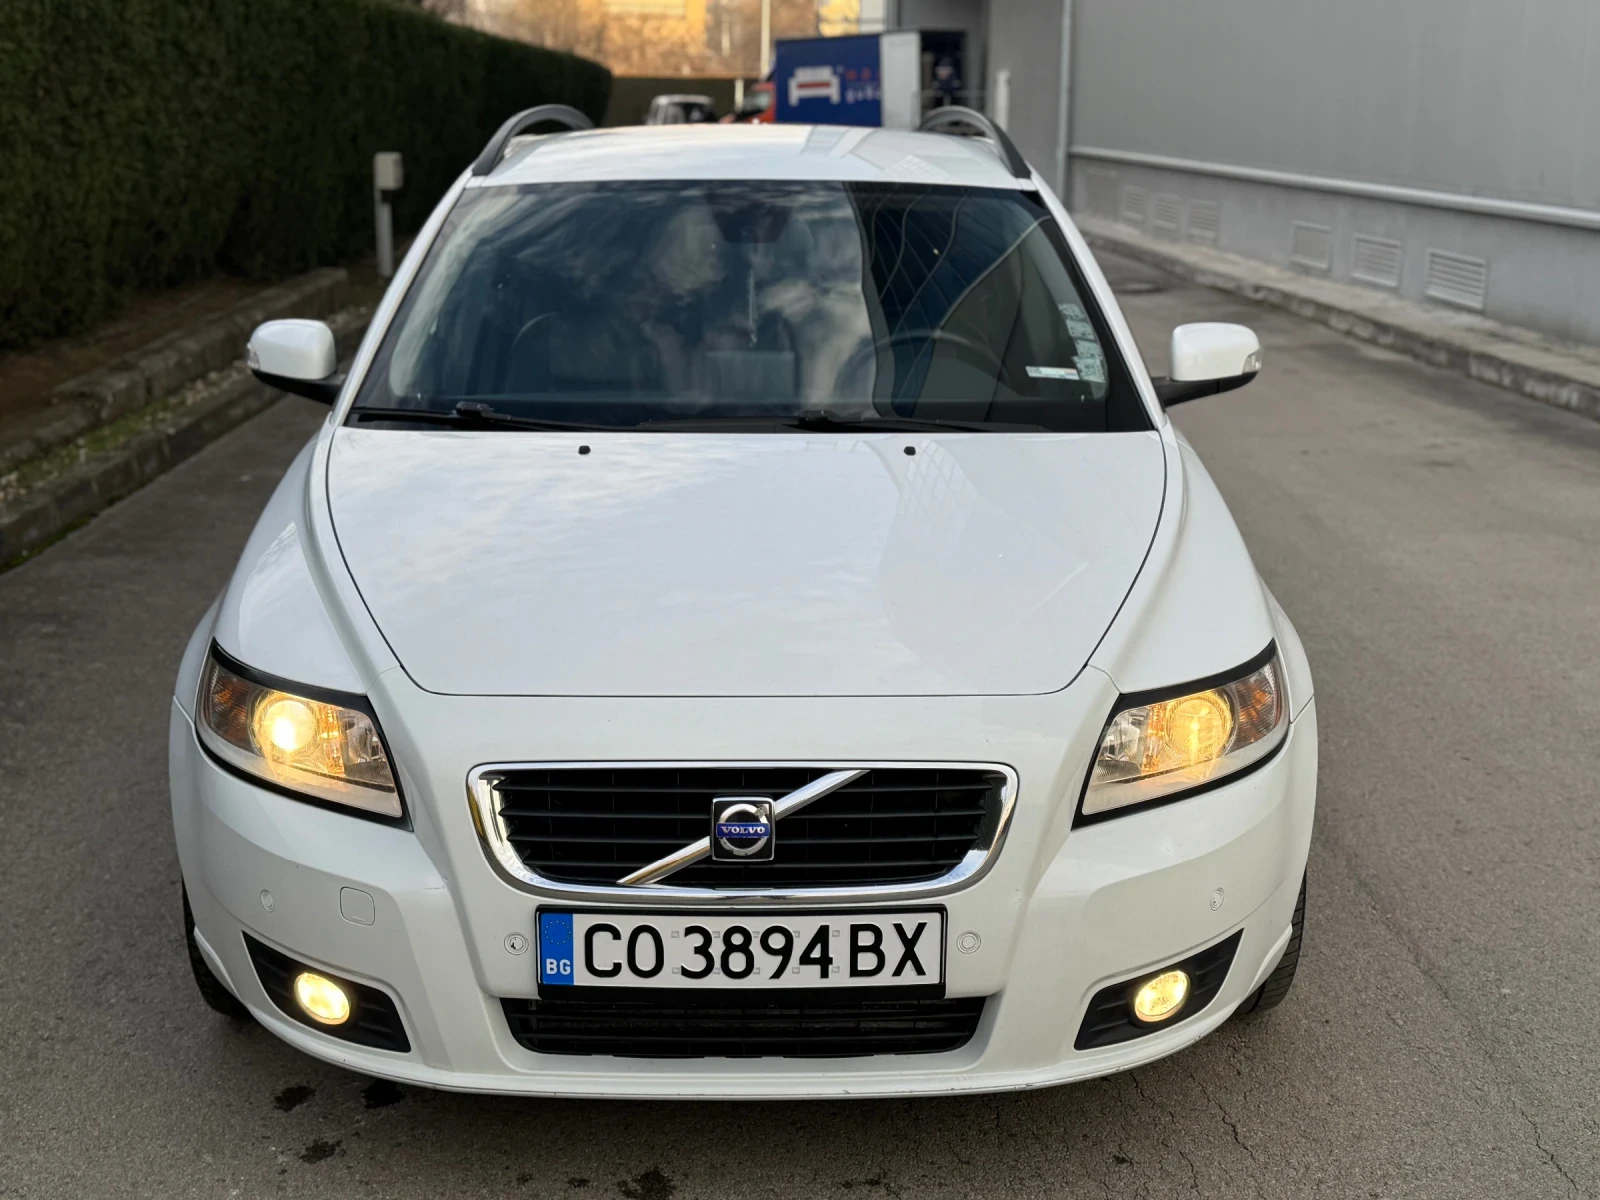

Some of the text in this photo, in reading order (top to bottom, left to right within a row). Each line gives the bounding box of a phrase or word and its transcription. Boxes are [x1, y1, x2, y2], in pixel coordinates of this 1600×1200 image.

[720, 826, 766, 834] VOLVO
[681, 924, 833, 979] 3894
[849, 922, 928, 977] BX
[546, 958, 571, 976] BG
